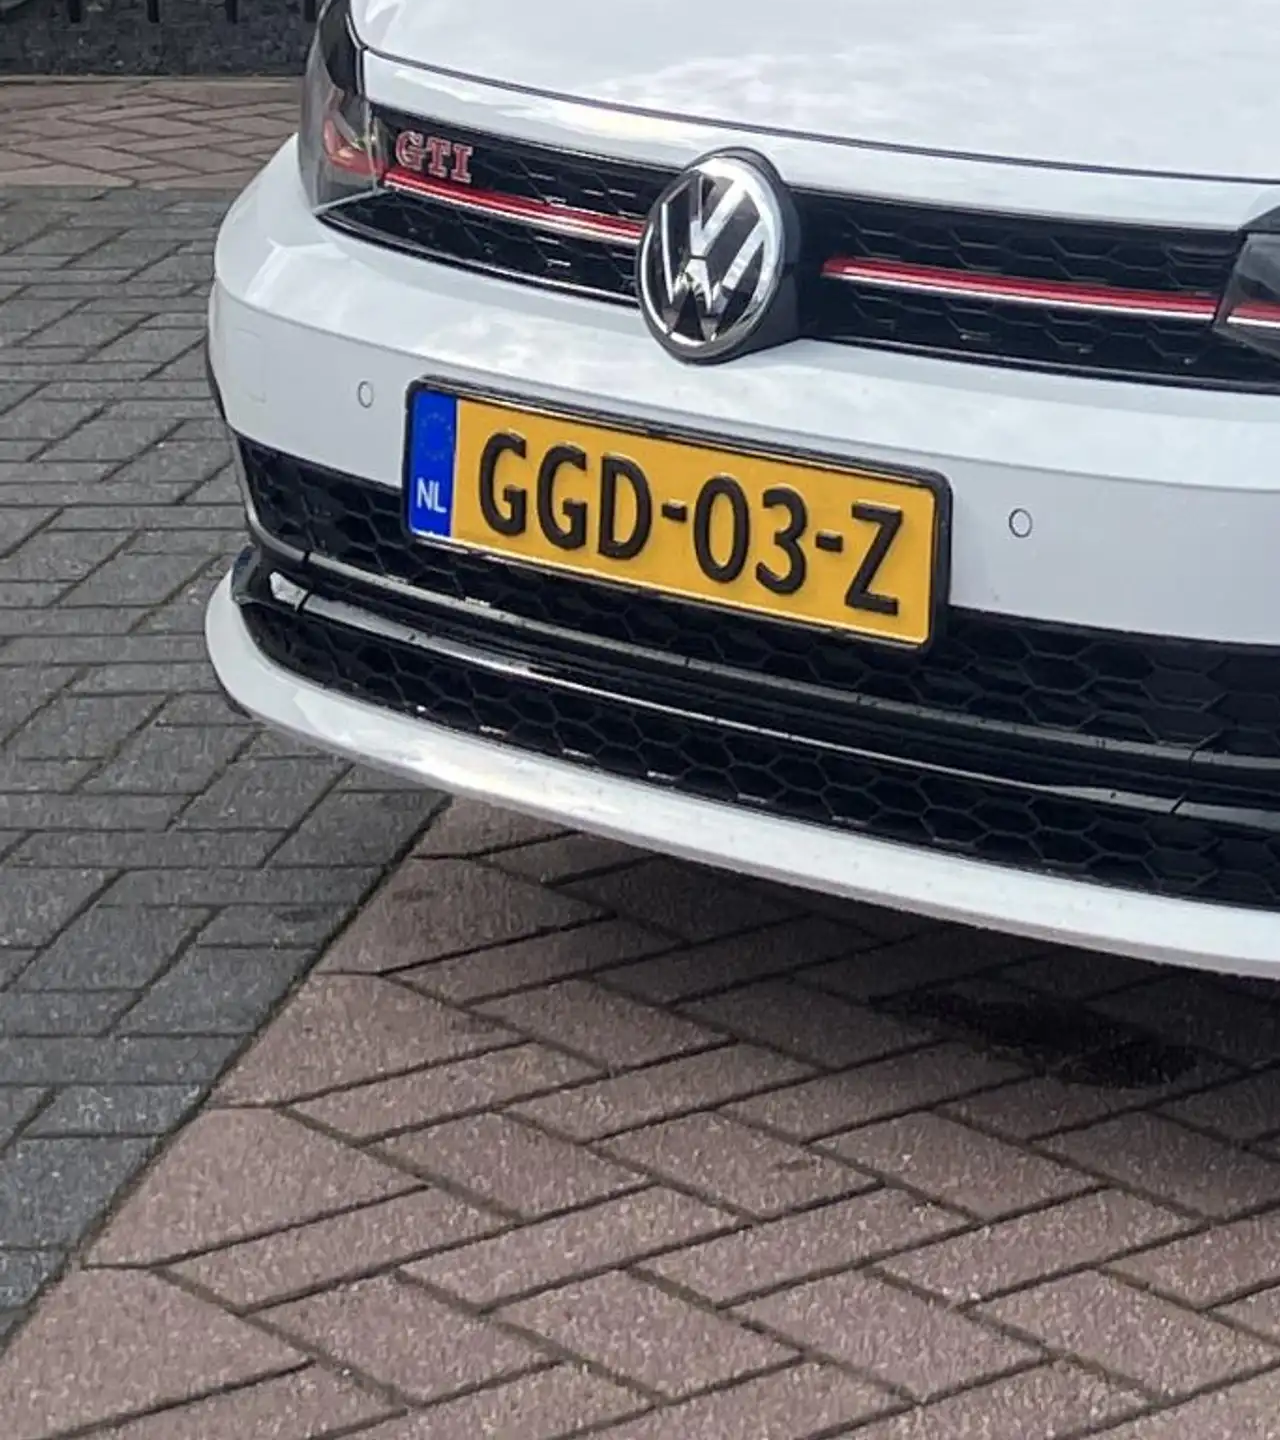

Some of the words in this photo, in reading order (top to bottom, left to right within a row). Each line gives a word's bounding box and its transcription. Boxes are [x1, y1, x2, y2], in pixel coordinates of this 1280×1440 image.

[395, 129, 475, 184] GTI
[416, 475, 447, 515] NL
[478, 429, 904, 617] GGD-03-Z
